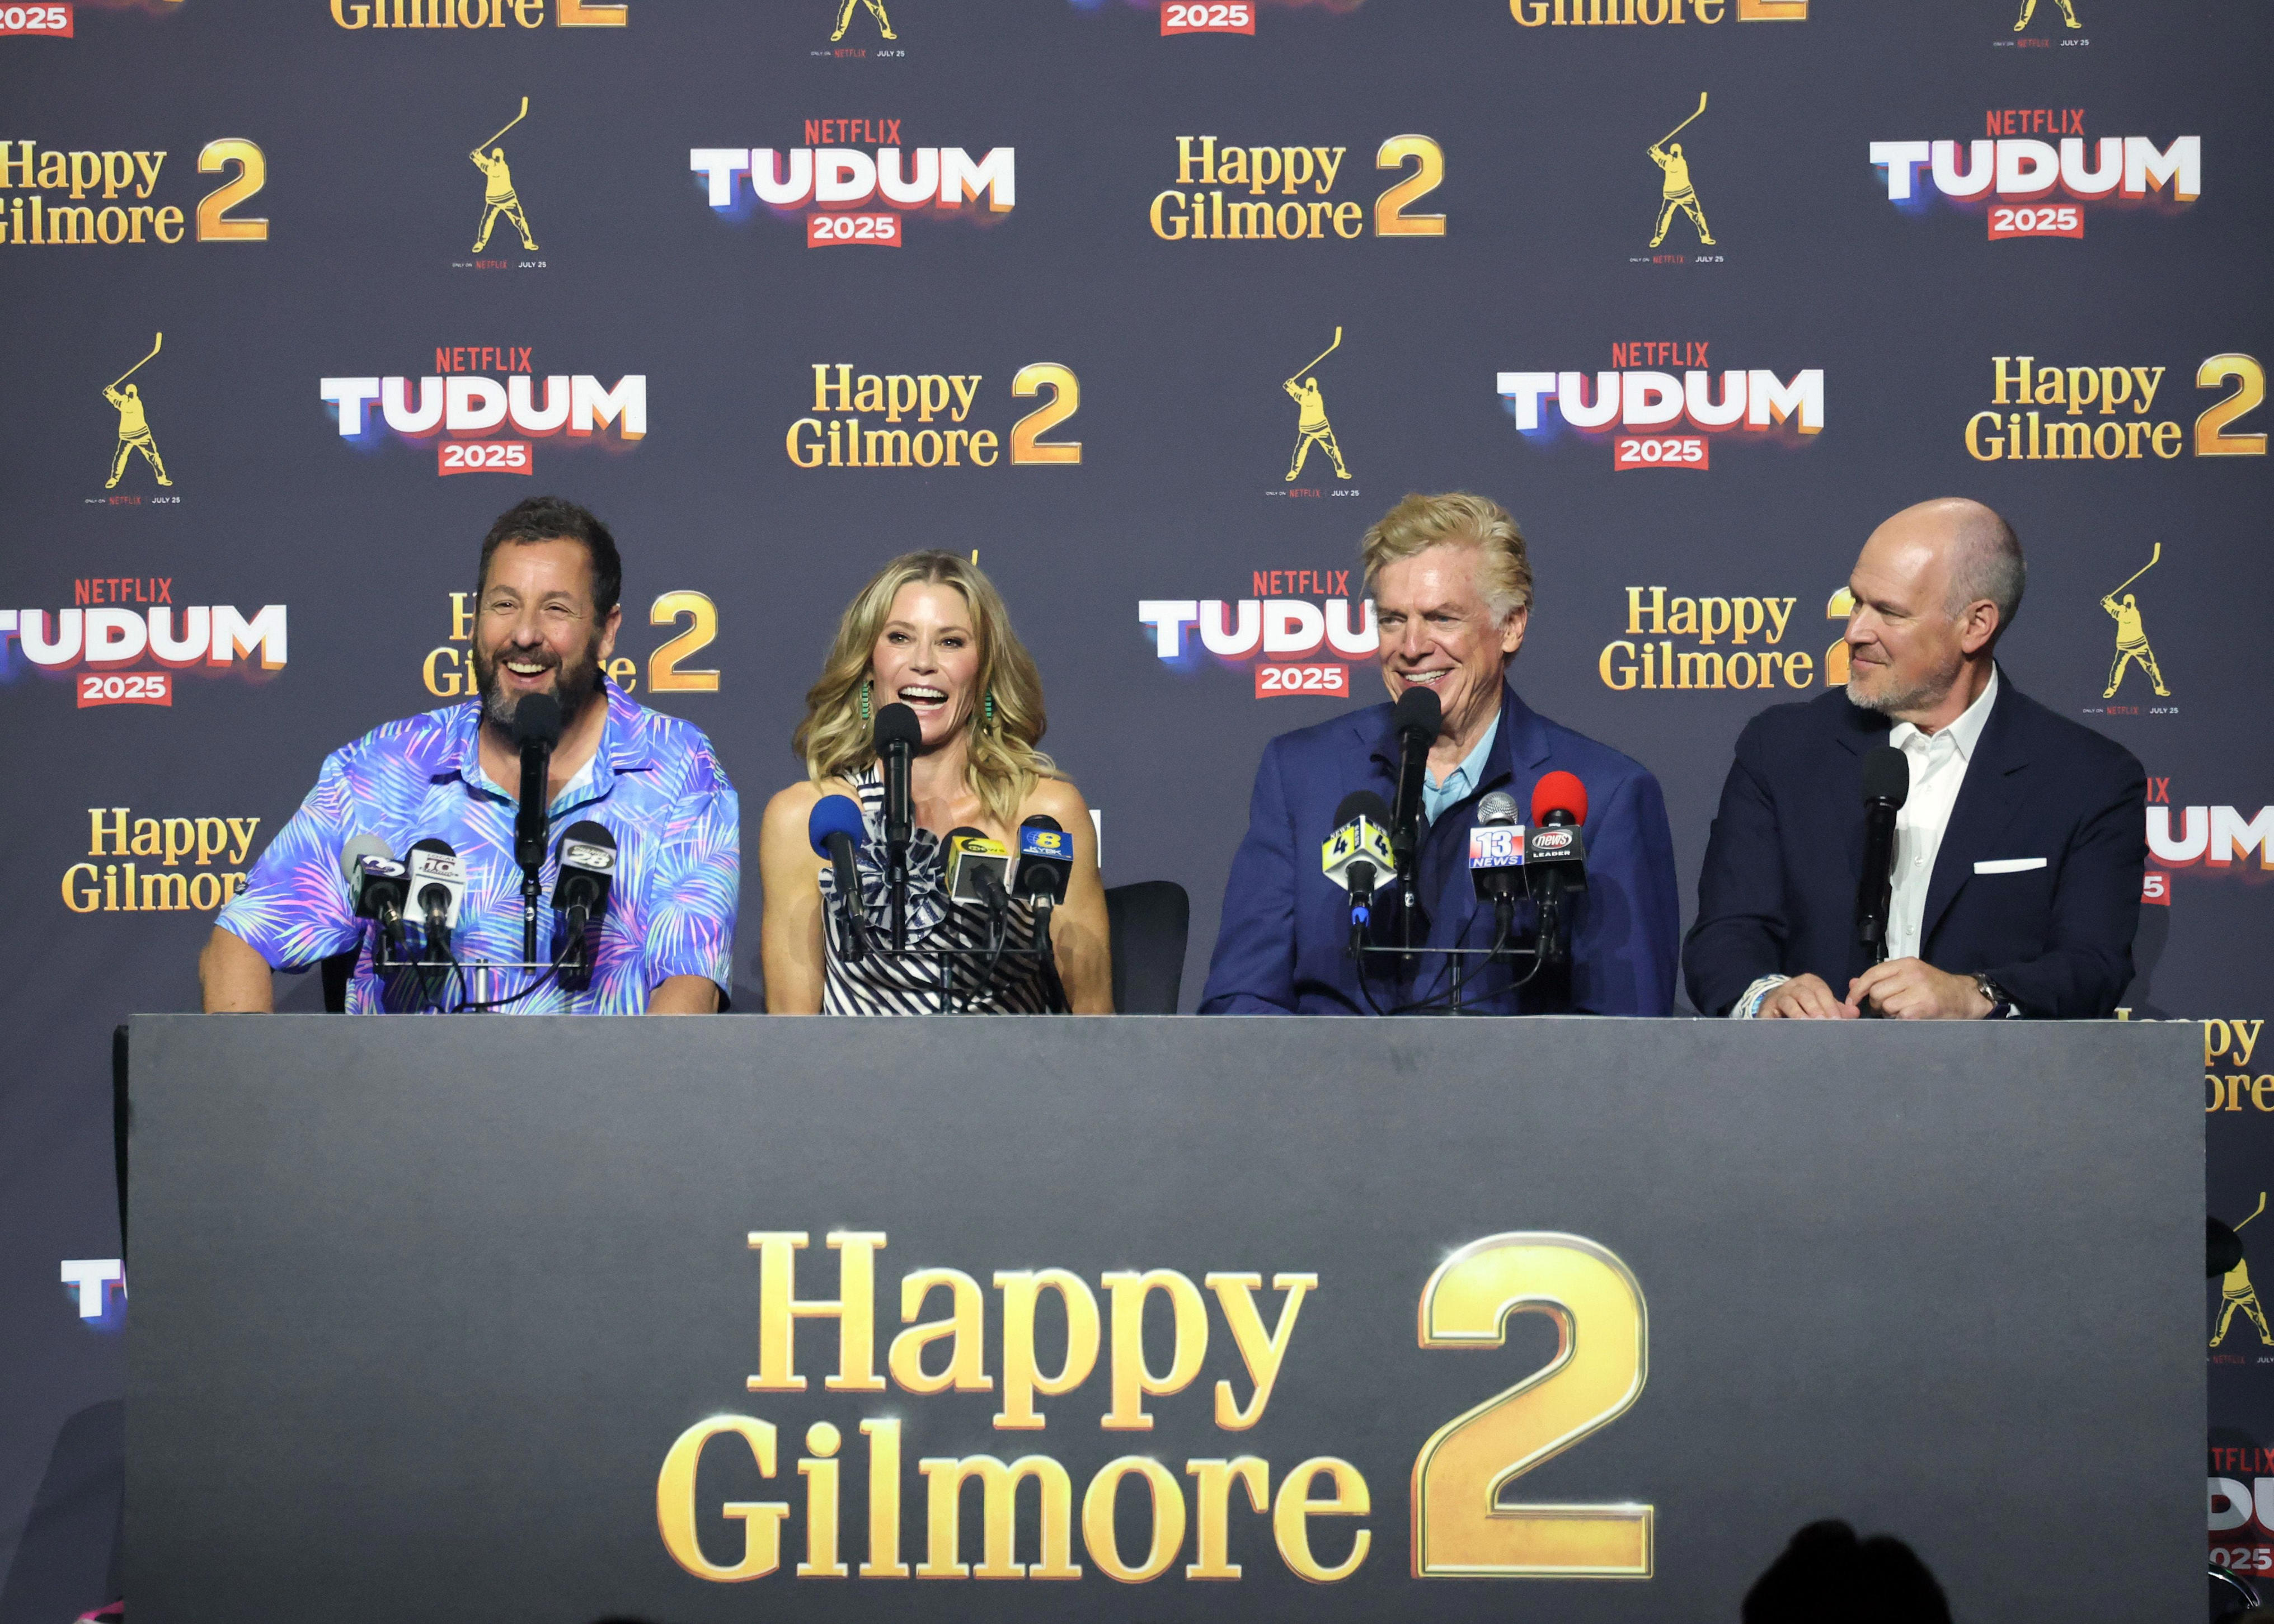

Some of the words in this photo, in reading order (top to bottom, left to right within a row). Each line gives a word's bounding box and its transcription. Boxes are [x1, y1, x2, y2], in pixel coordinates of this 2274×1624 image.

[0, 7, 67, 29] 025
[1167, 4, 1248, 27] 2025
[834, 49, 866, 58] NETFLIX
[2017, 39, 2050, 48] NETFLIX
[805, 119, 901, 144] NETFLIX
[1986, 110, 2084, 136] NETFLIX
[0, 140, 167, 199] Happy
[690, 148, 1014, 207] TUDUM
[1176, 136, 1346, 194] Happy
[1869, 136, 2201, 201] TUDUM
[197, 138, 269, 242] 2
[1375, 134, 1447, 237] 2
[0, 195, 184, 244] ilmore
[813, 216, 895, 239] 2025
[1150, 190, 1363, 241] Gilmore
[1994, 209, 2078, 232] 2025
[476, 261, 507, 269] NETFLIX
[1653, 255, 1684, 264] NETFLIX
[435, 347, 532, 373] NETFLIX
[1612, 342, 1708, 368] NETFLIX
[812, 364, 982, 422] Happy
[1991, 356, 2165, 415] Happy
[321, 375, 646, 435] TUDUM
[1497, 369, 1824, 430] TUDUM
[2195, 353, 2268, 457] 2
[1011, 362, 1082, 465] 2
[786, 418, 999, 468] Gilmore
[1965, 412, 2182, 461] Gilmore
[444, 445, 526, 468] 2025
[1620, 439, 1703, 462] 2025
[109, 496, 141, 505] NETFLIX
[1290, 489, 1320, 498] NETFLIX
[75, 578, 172, 605] NETFLIX
[1253, 570, 1349, 596] NETFLIX
[1625, 586, 1797, 644] Happy
[650, 590, 720, 693] 2
[1139, 599, 1380, 658] TUDU
[1599, 641, 1813, 690] Gilmore
[83, 676, 166, 699] 2025
[1261, 668, 1342, 690] 2025
[2107, 706, 2139, 715] NETFLIX
[88, 808, 260, 865] Happy
[961, 839, 988, 853] 6
[1036, 832, 1061, 849] 8
[1333, 836, 1348, 854] 4
[1375, 834, 1388, 857] 4
[1476, 831, 1512, 858] 13
[1537, 834, 1567, 847] news
[363, 855, 405, 877] 3
[424, 859, 453, 874] 10
[568, 850, 610, 868] 28
[1473, 856, 1518, 867] NEWS
[61, 863, 246, 913] Gilmor
[747, 1231, 1318, 1430] Happy
[1412, 1231, 1655, 1580] 2
[2212, 1447, 2274, 1474] TFLIX
[656, 1414, 1371, 1583] Gilmore
[2210, 1547, 2272, 1570] 025
